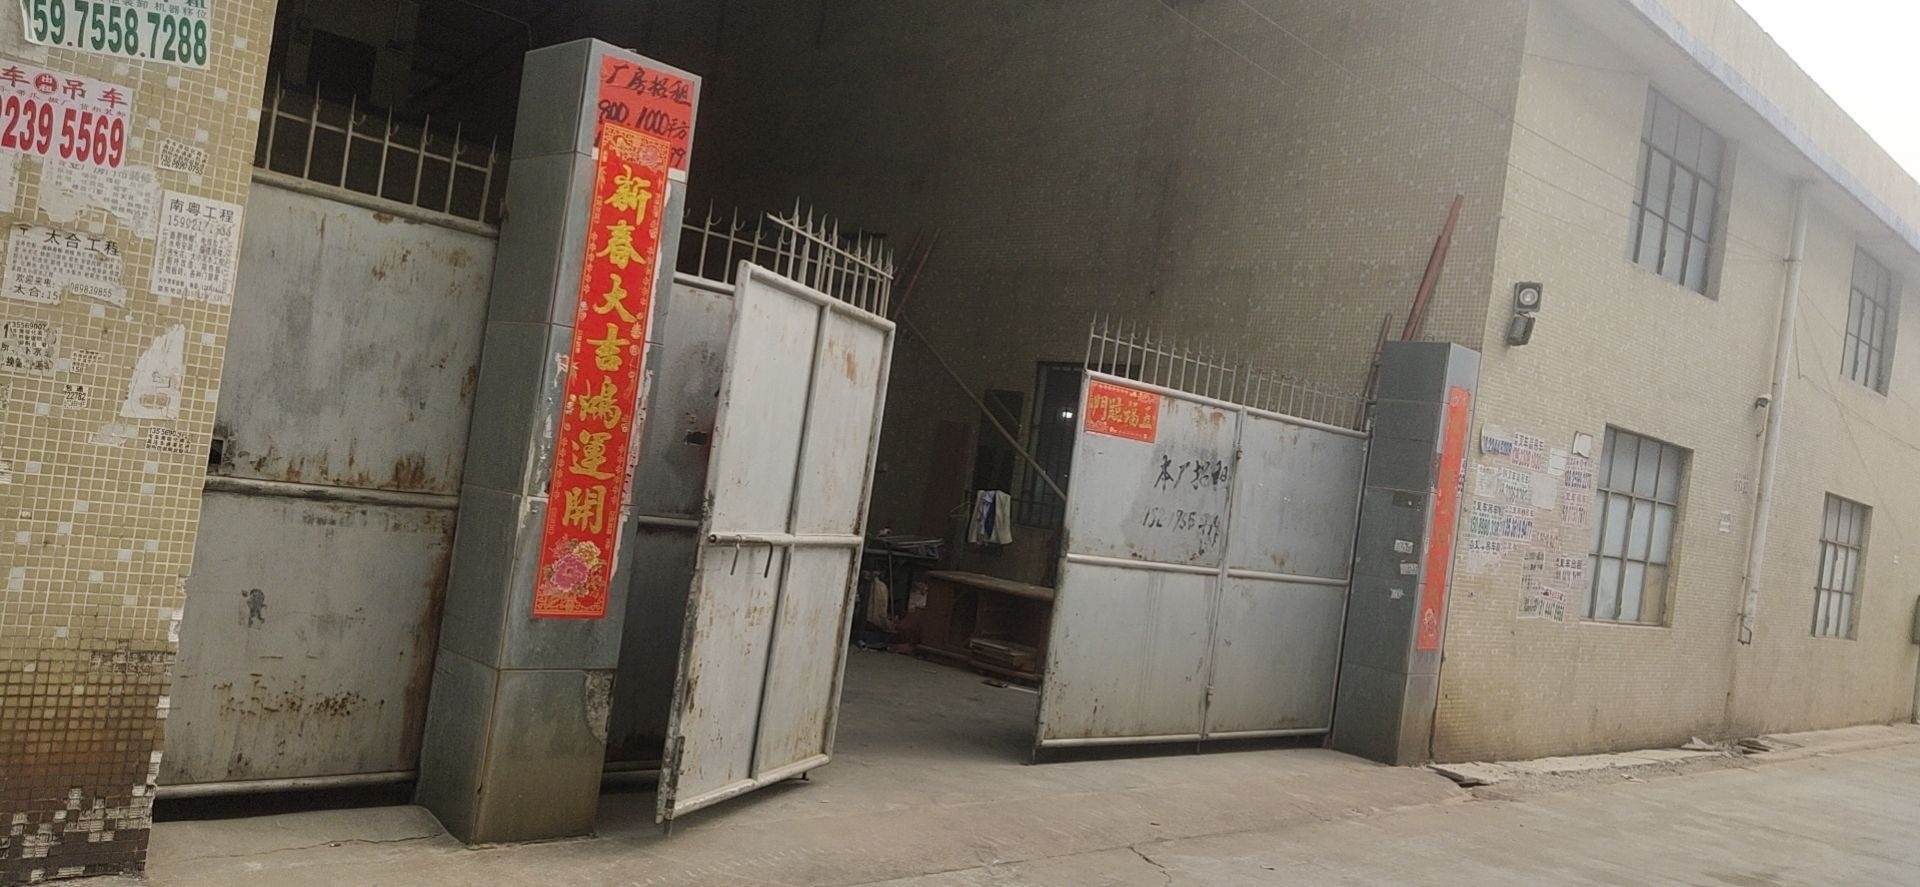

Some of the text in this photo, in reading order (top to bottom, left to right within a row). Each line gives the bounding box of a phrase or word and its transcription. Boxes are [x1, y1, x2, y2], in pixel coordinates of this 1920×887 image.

[0, 95, 54, 155] 239
[59, 107, 124, 168] 5569
[168, 197, 235, 225] 南粤工程
[43, 228, 120, 257] 太合工程
[1154, 454, 1229, 491] 本厂招租
